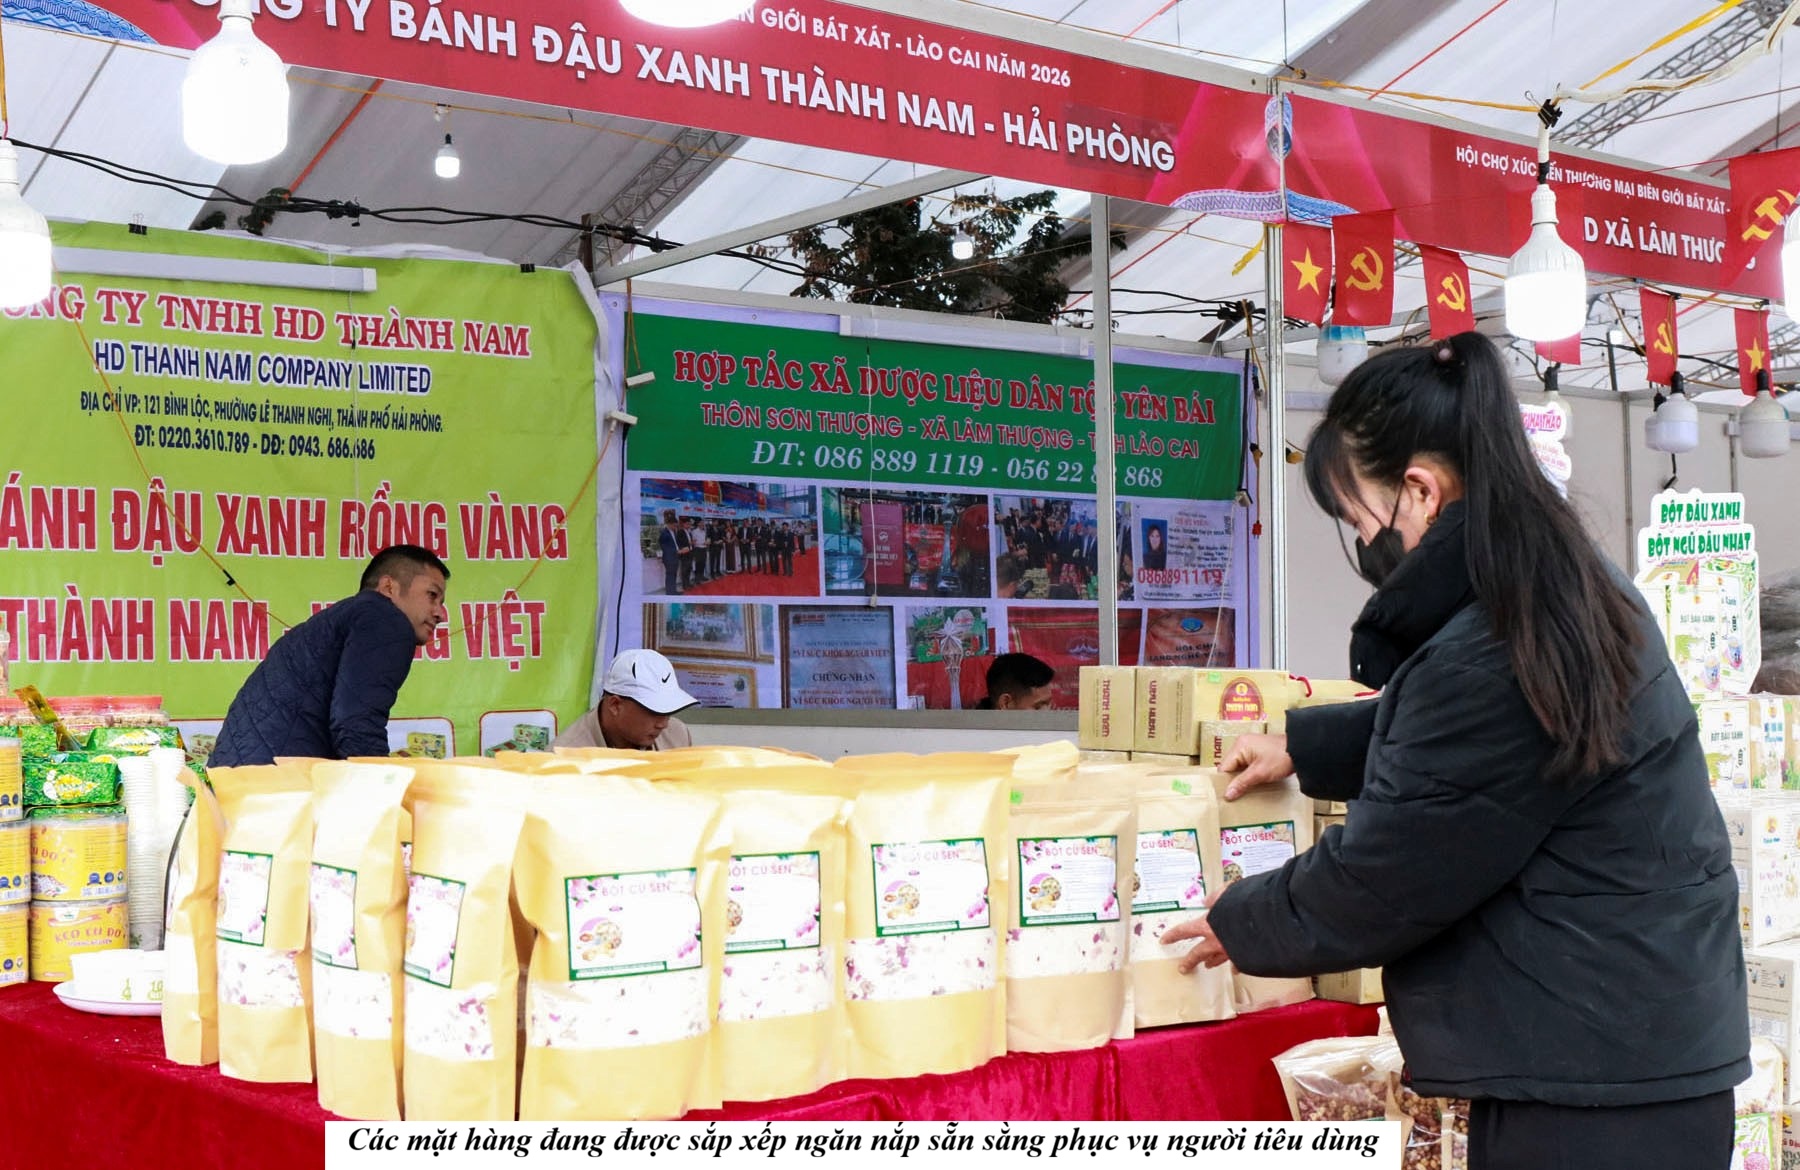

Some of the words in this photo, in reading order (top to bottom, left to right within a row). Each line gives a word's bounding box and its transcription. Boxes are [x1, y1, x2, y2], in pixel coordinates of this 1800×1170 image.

[761, 5, 806, 34] GIỚI
[813, 16, 849, 41] BÁT
[854, 25, 891, 50] XÁT
[907, 33, 943, 61] LÀO
[949, 46, 981, 69] CAI
[986, 52, 1026, 79] NĂM
[1031, 63, 1071, 88] 2026
[390, 0, 517, 56] BÁNH
[531, 22, 622, 80] ĐẬU
[634, 43, 751, 97] XANH
[760, 66, 887, 120] THÀNH
[897, 91, 976, 136] NAM
[1004, 107, 1059, 152] HẢI
[1065, 122, 1176, 173] PHÒNG
[1456, 146, 1479, 166] HỘI
[1481, 152, 1509, 172] CHỢ
[1512, 154, 1537, 177] XÚC
[1614, 176, 1635, 198] MẠI
[1637, 180, 1660, 201] BIÊN
[1662, 189, 1685, 207] GIỚI
[1686, 192, 1705, 211] BÁT
[1706, 195, 1726, 215] XÁT
[1604, 218, 1634, 249] XÃ
[1639, 222, 1678, 257] LÂM
[97, 290, 147, 325] TY
[157, 295, 263, 336] TNHH
[273, 306, 325, 341] HD
[336, 308, 454, 351] THÀNH
[463, 322, 531, 357] NAM
[96, 342, 125, 371] HD
[131, 344, 200, 377] THANH
[205, 351, 251, 381] NAM
[258, 354, 352, 389] COMPANY
[359, 364, 431, 393] LIMITED
[674, 350, 737, 391] HỢP
[742, 350, 803, 391] TÁC
[810, 357, 852, 395] XÃ
[858, 367, 937, 406] DƯỢC
[944, 368, 1003, 412] LIỆU
[1009, 374, 1064, 412] DÂN
[1122, 386, 1168, 421] YÊN
[1173, 391, 1217, 425] BÁI
[81, 391, 100, 416] ĐỊA
[102, 386, 121, 412] CHỈ
[124, 394, 141, 413] VP:
[144, 395, 160, 415] 121
[164, 392, 188, 417] BÌNH
[191, 394, 213, 423] LỘC,
[214, 397, 257, 422] PHƯỜNG
[259, 399, 270, 423] LÊ
[272, 405, 304, 425] THANH
[307, 407, 334, 431] NGHỊ,
[337, 404, 368, 429] THÀNH
[370, 404, 391, 430] PHỐ
[392, 406, 408, 431] HẢI
[410, 409, 443, 432] PHÒNG.
[701, 400, 760, 428] THÔN
[766, 407, 812, 432] SƠN
[817, 410, 904, 440] THƯỢNG
[921, 415, 949, 442] XÃ
[953, 417, 993, 445] LÂM
[996, 424, 1073, 452] THƯỢNG
[1130, 431, 1164, 456] LÀO
[1168, 438, 1200, 459] CAI
[135, 425, 155, 447] ĐT:
[158, 426, 249, 453] 0220.3610.789
[261, 434, 285, 455] DĐ:
[289, 436, 324, 457] 0943.
[752, 441, 806, 467] ĐT:
[814, 445, 863, 471] 086
[871, 448, 917, 473] 889
[926, 451, 984, 478] 1119
[1007, 457, 1049, 481] 056
[1056, 461, 1083, 483] 22
[1124, 466, 1163, 488] 868
[111, 477, 202, 567] ĐẬU
[216, 493, 327, 558] XANH
[339, 481, 448, 559] RỒNG
[460, 492, 568, 560] VÀNG
[1660, 498, 1684, 525] BỘT
[1711, 501, 1741, 522] XANH
[1647, 532, 1671, 558] BỘT
[0, 584, 155, 661] THÀNH
[170, 600, 269, 661] NAM
[460, 590, 545, 670] VIỆT
